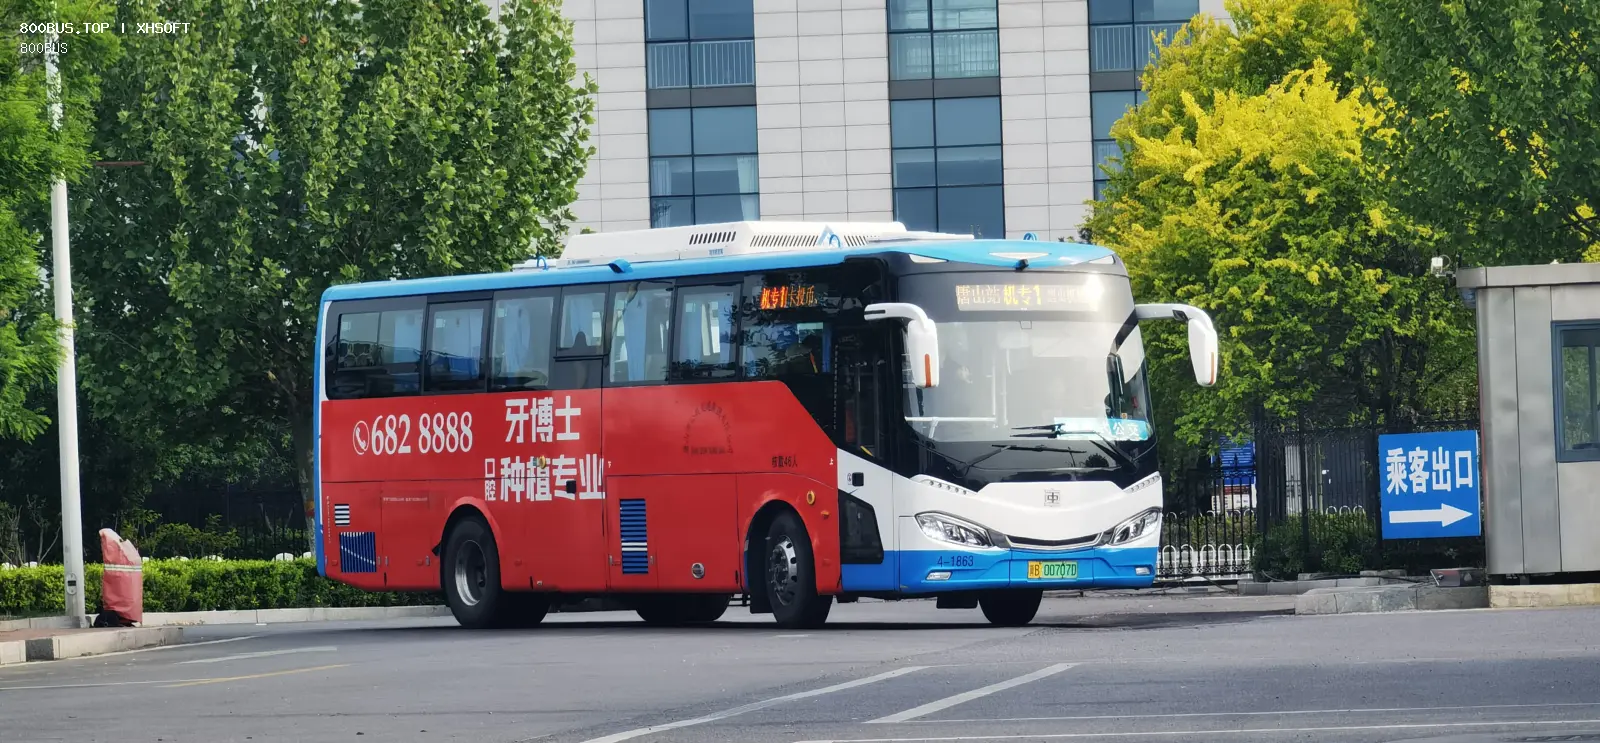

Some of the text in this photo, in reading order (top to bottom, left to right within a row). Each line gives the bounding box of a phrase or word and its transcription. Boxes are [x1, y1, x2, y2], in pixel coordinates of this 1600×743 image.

[955, 284, 1001, 305] 唐山站
[1003, 284, 1043, 306] 机专1
[371, 411, 473, 456] 682 8888
[504, 395, 582, 444] 牙博士
[484, 457, 497, 501] 口腔
[500, 453, 606, 503] 种植专业
[1385, 446, 1473, 496] 乘客出口
[936, 555, 974, 568] 4-1863
